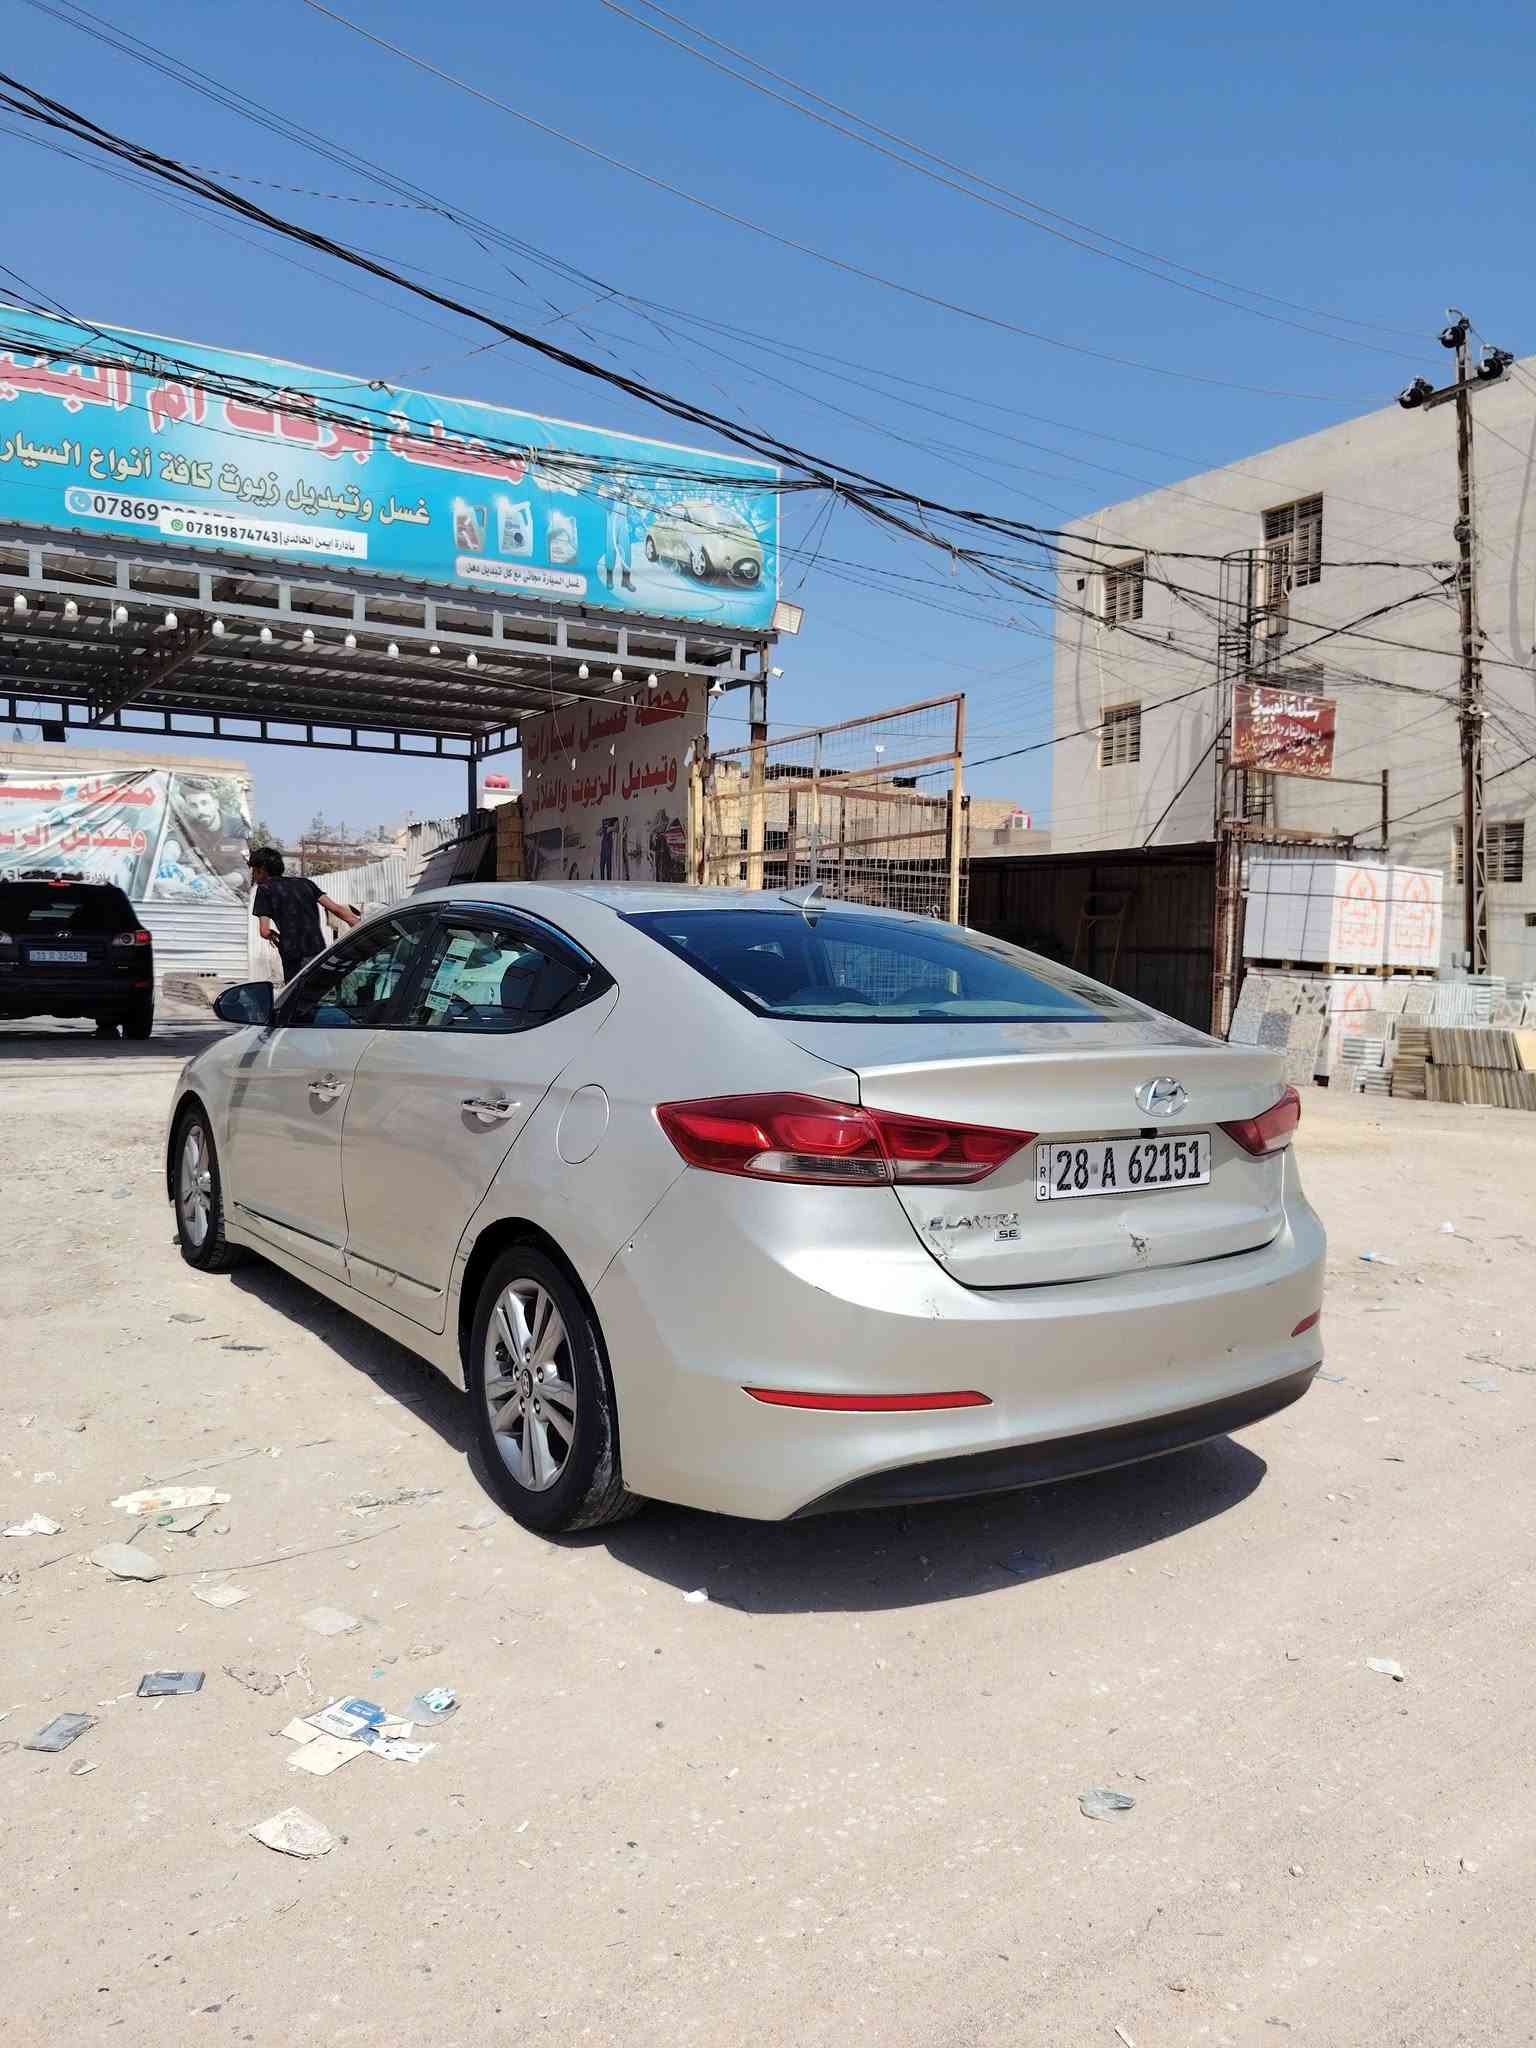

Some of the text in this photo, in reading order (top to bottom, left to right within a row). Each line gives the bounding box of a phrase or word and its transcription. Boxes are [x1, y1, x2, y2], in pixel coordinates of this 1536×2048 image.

[0, 431, 430, 526] غسل وتبديل زيوت كافة أنواع السيار
[572, 762, 617, 807] الزيوت
[622, 754, 678, 801] وتبديل
[1056, 1140, 1201, 1191] 28 A 62151
[999, 1230, 1018, 1239] SE
